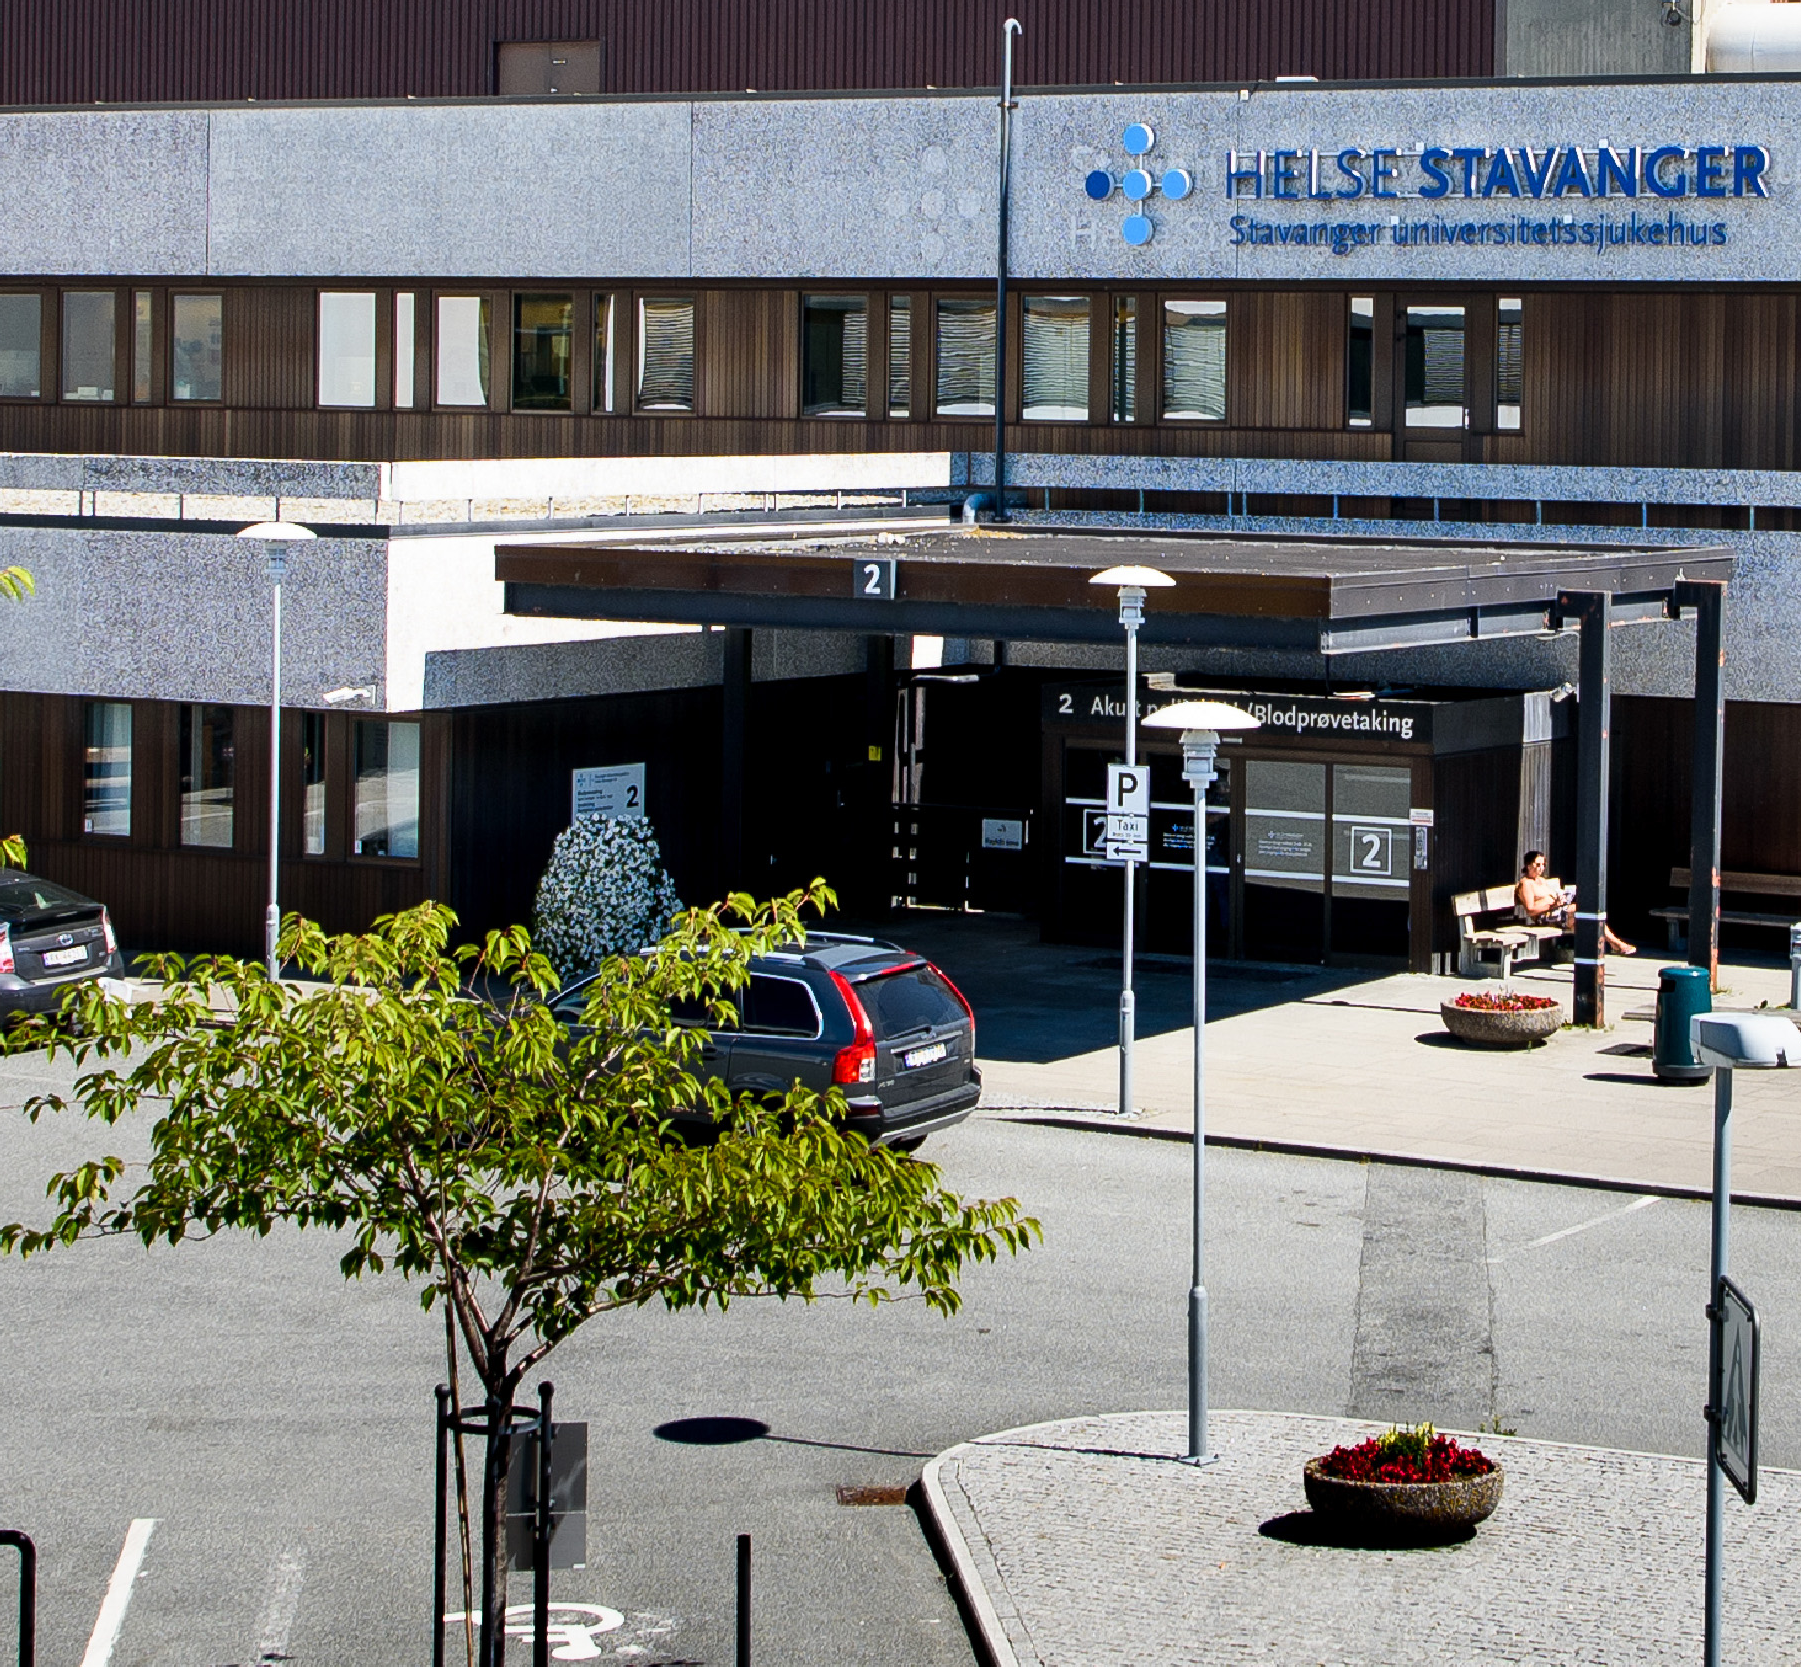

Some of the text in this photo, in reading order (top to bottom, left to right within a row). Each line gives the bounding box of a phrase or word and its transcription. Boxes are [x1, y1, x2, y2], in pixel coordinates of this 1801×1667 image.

[1225, 147, 1400, 200] HELSE
[1419, 145, 1771, 200] STAVANGER
[1229, 215, 1381, 255] Stavanger
[1392, 213, 1728, 256] universitetssjukehus
[863, 564, 881, 595] 2
[1058, 693, 1074, 714] 2
[1090, 694, 1142, 717] Akut
[627, 784, 640, 809] 2
[1117, 772, 1139, 807] P
[1093, 816, 1108, 848] 2
[1117, 819, 1140, 832] Taxi
[1362, 834, 1382, 868] 2
